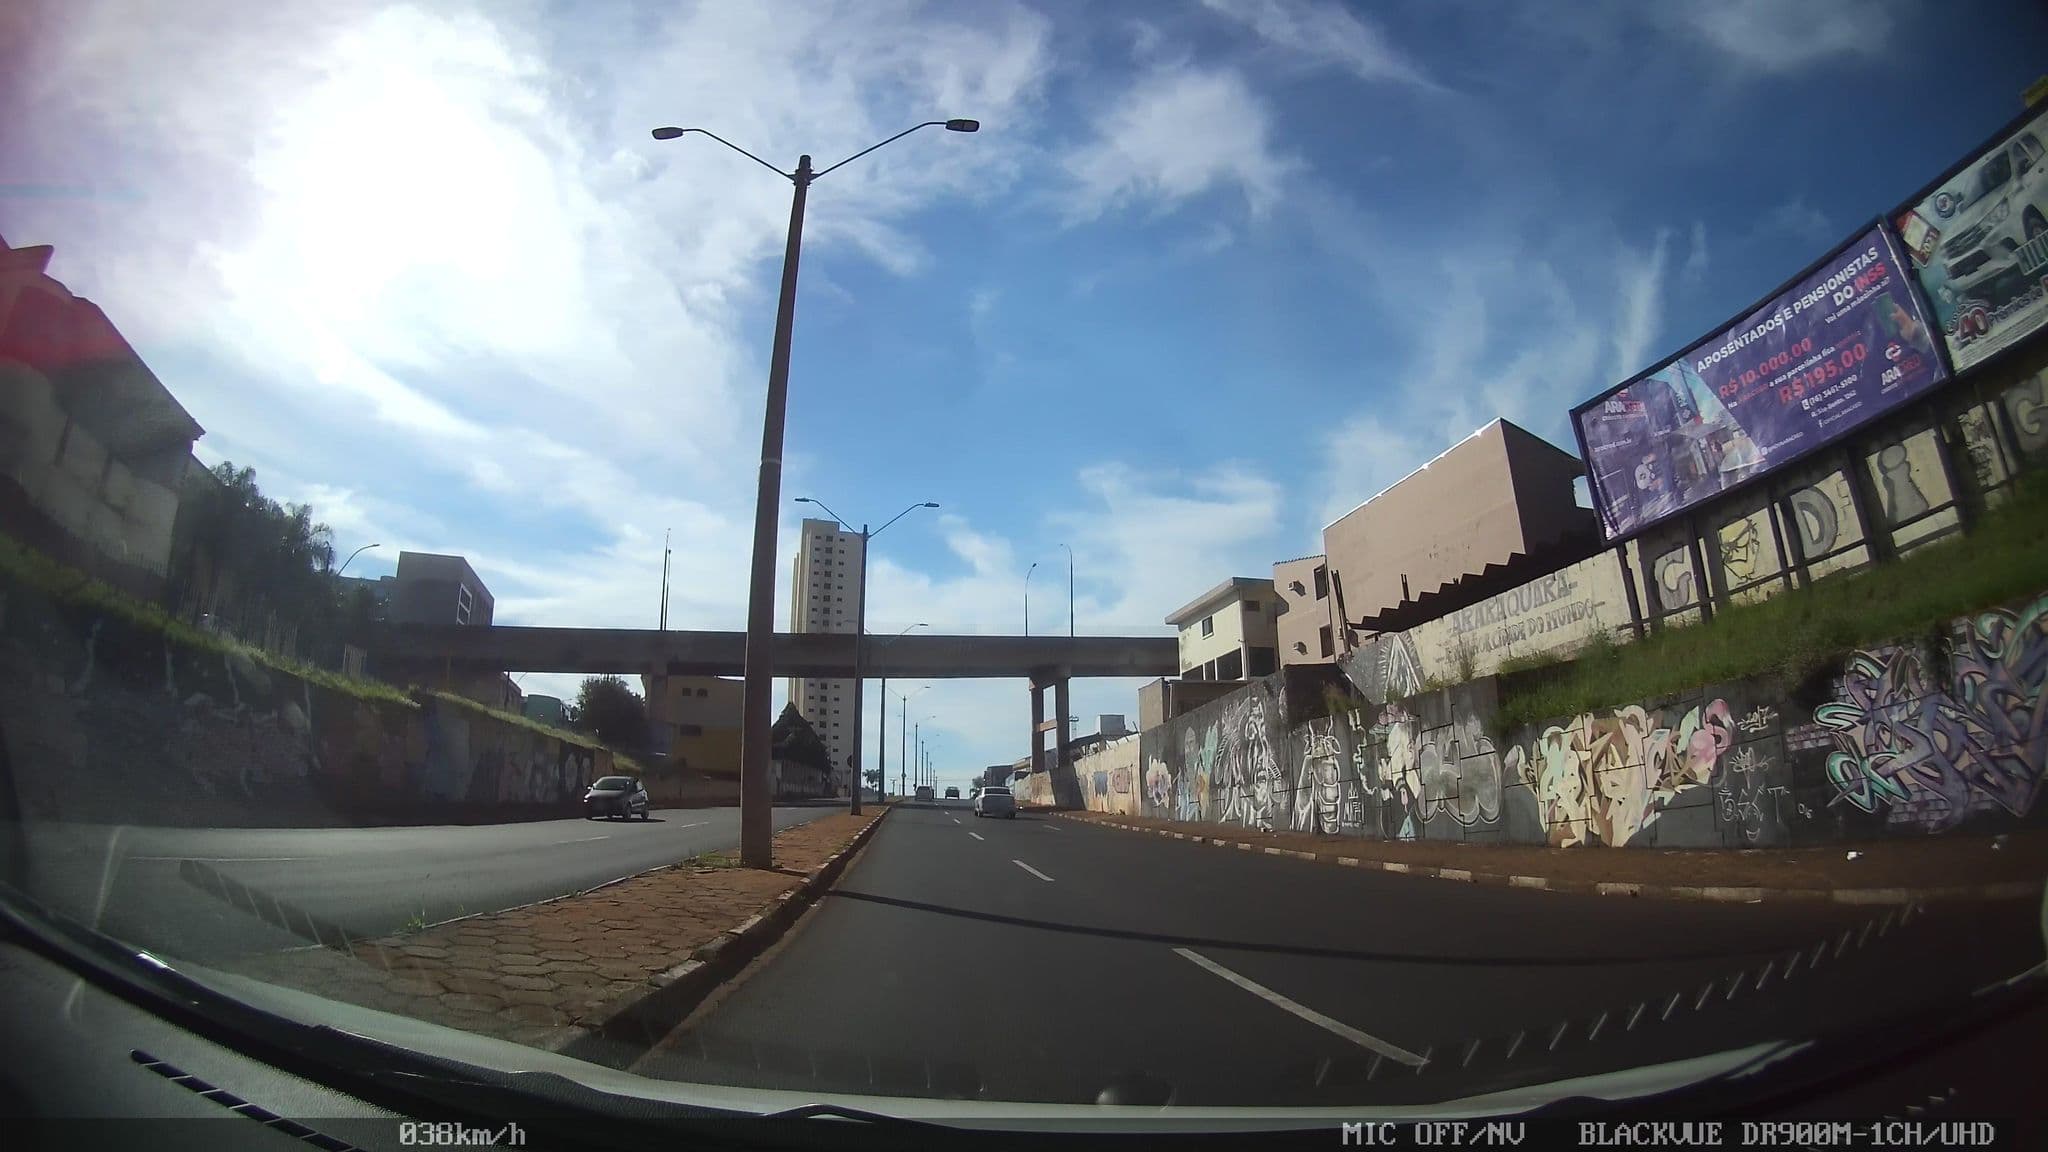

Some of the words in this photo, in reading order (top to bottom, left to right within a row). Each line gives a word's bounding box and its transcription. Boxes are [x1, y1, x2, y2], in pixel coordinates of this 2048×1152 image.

[1697, 312, 1784, 373] APOSENTADOS
[1783, 307, 1793, 321] E
[1793, 246, 1879, 314] PENSIONISTAS
[1833, 285, 1854, 307] DO
[1959, 307, 1989, 341] 40
[1719, 377, 1739, 399] R$
[1779, 377, 1805, 404] R$
